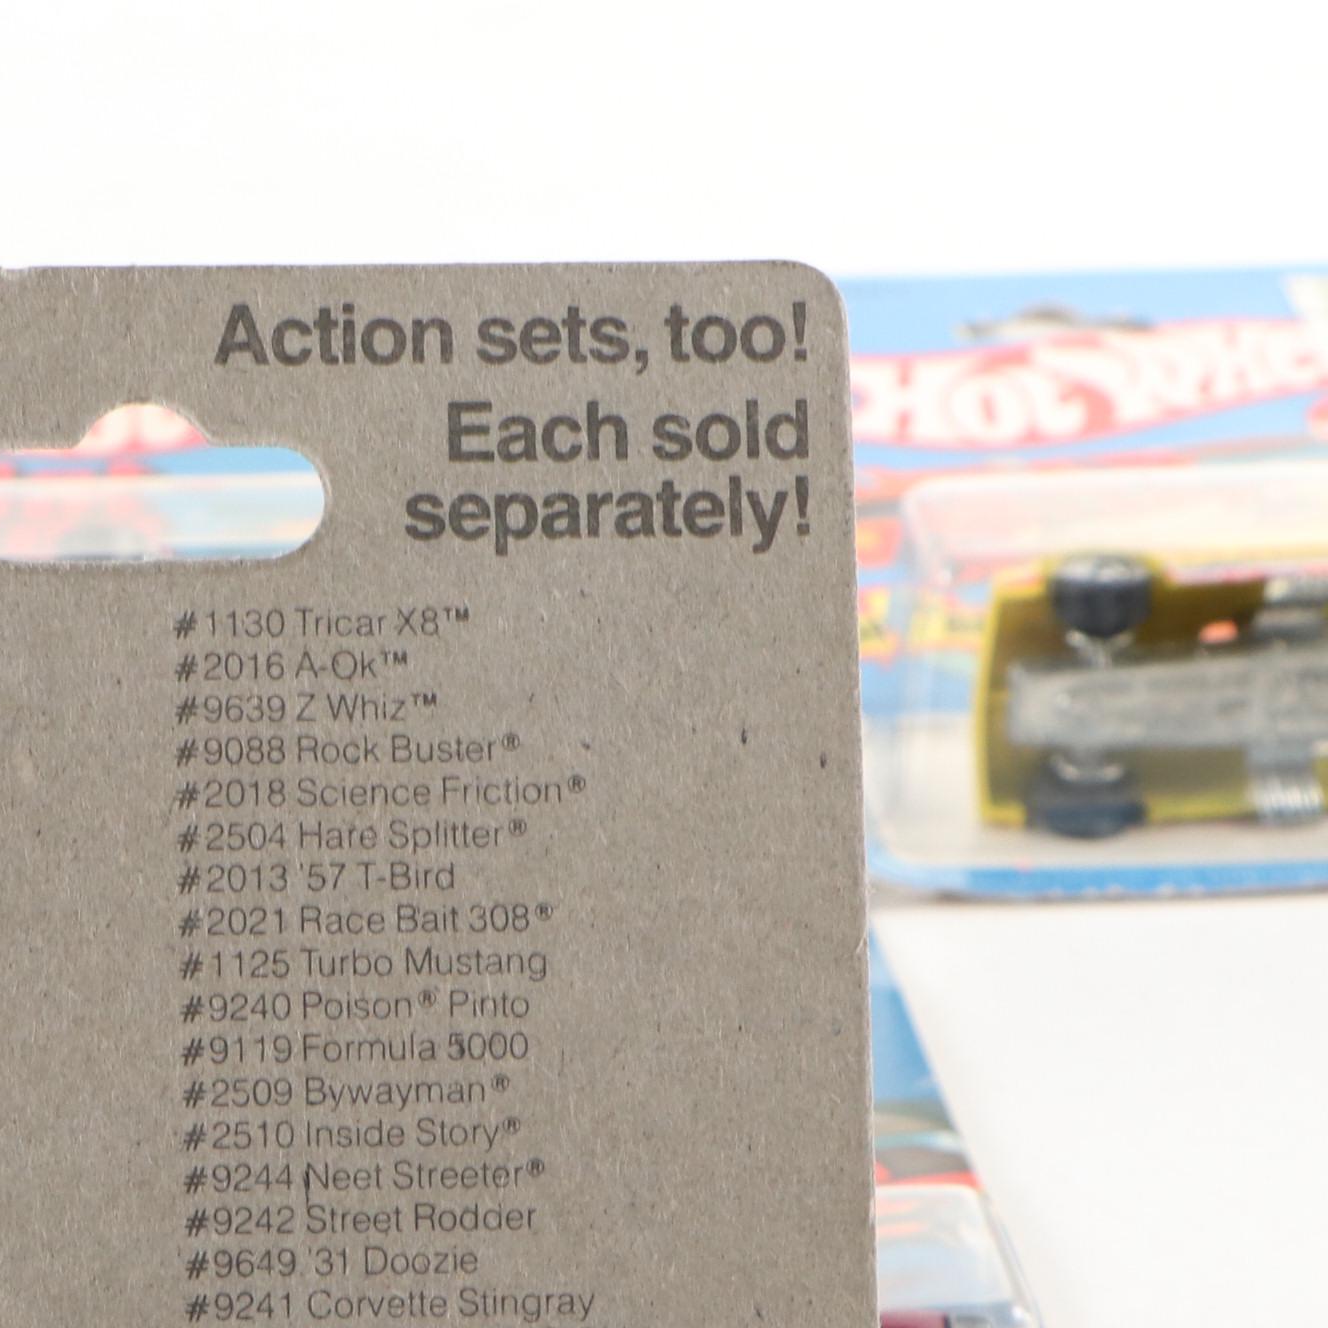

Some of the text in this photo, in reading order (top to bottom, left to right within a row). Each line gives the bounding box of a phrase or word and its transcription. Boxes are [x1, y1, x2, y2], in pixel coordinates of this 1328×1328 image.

[214, 300, 807, 375] Action sets, too!
[447, 398, 809, 463] Each sold
[405, 475, 810, 557] separately!
[296, 608, 384, 636] Tricar
[297, 735, 378, 765] Rock
[298, 779, 430, 806] Science
[299, 821, 377, 849] Hare
[358, 861, 454, 890] T-Bird
[301, 904, 458, 934] Race Bait
[301, 947, 547, 982] Turbo Mustang
[450, 990, 529, 1018] Pinto
[303, 1033, 436, 1062] Formula
[307, 1120, 404, 1148] Inside
[305, 1203, 535, 1234] Street Rodder
[364, 1246, 477, 1276] Doozie
[308, 1288, 594, 1322] Corvette Stingray
